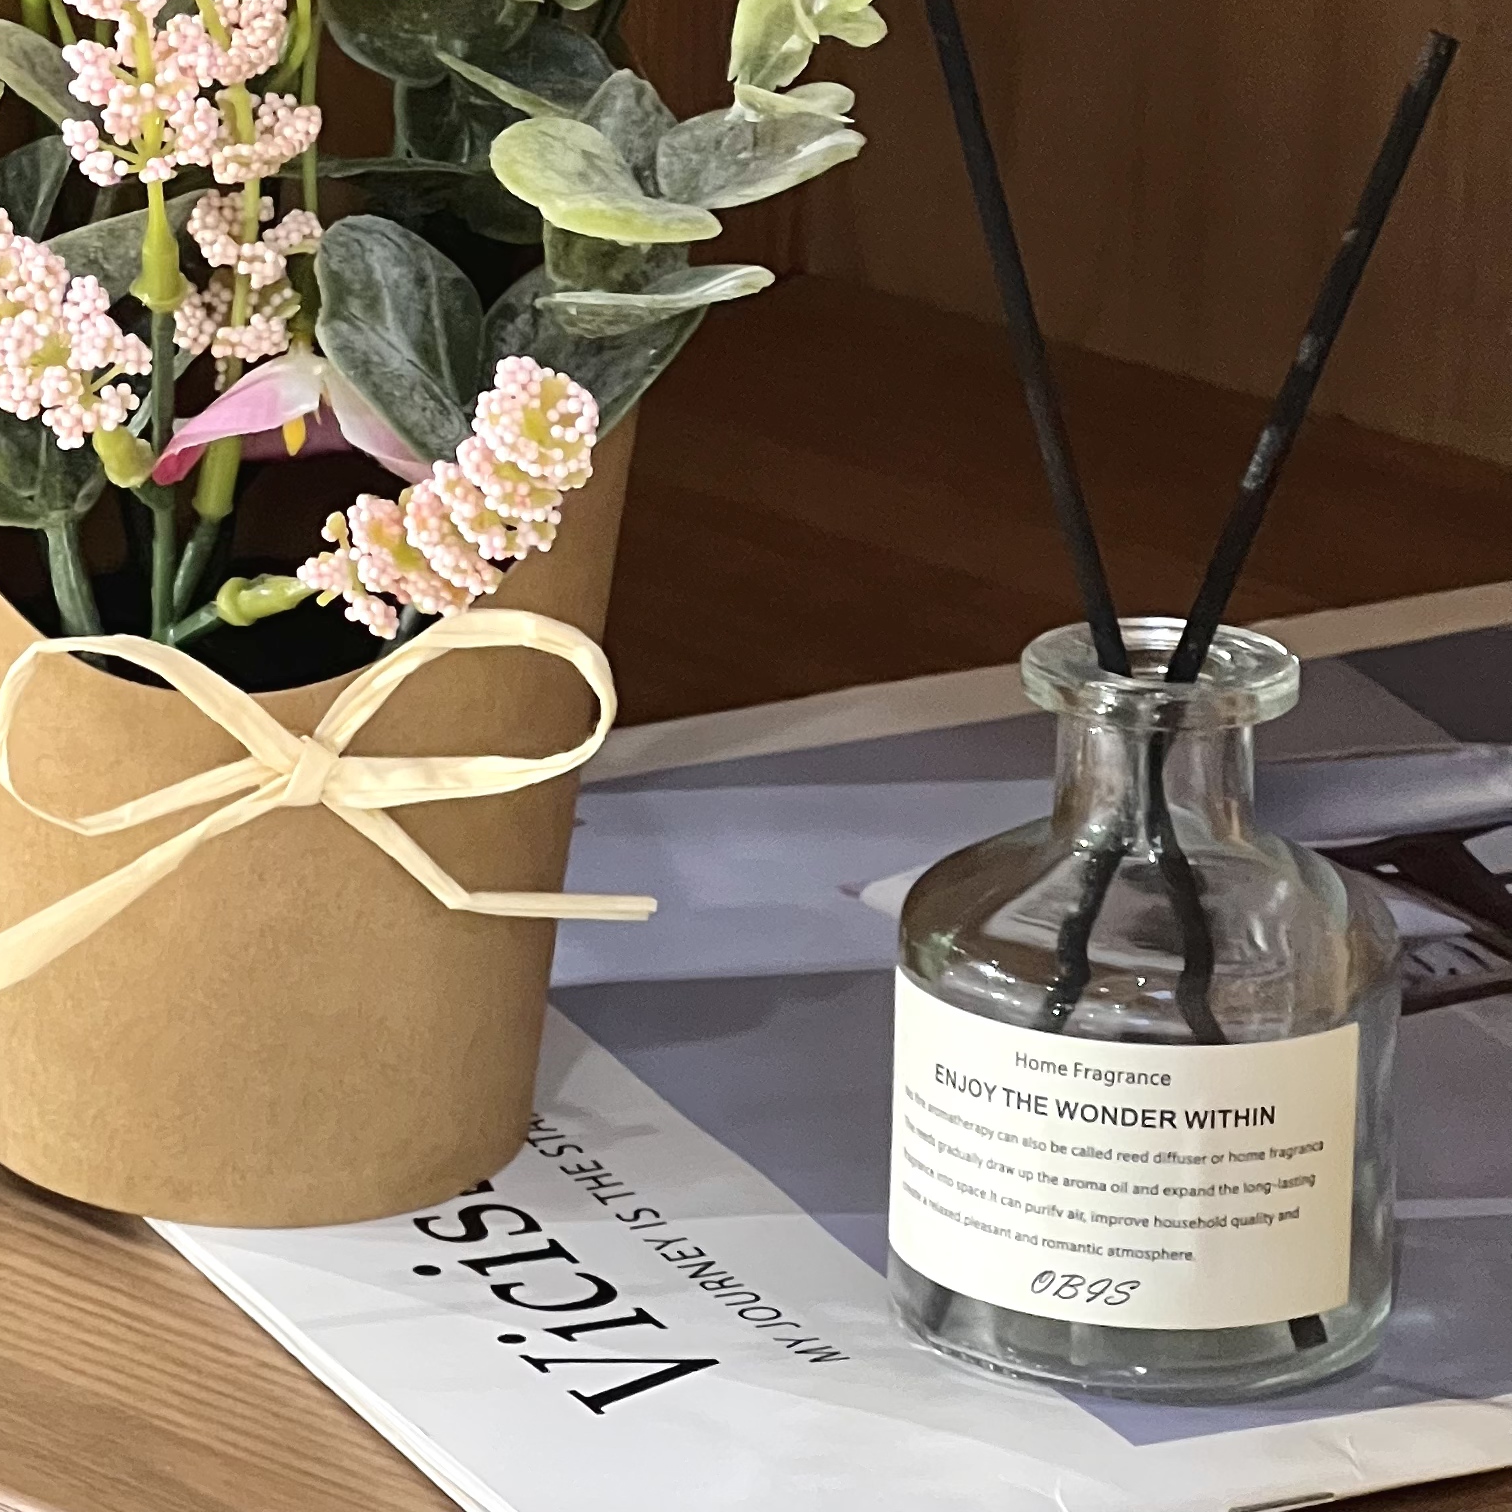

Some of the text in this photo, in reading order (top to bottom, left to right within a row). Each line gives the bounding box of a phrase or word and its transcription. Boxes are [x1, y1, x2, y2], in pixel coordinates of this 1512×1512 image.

[1015, 1051, 1172, 1087] Home Fragrance
[934, 1063, 1276, 1129] ENJOY THE WONDER WITHIN
[997, 1131, 1019, 1144] can
[1022, 1136, 1047, 1152] also
[1050, 1140, 1067, 1155] be
[1071, 1145, 1113, 1161] called
[1116, 1149, 1150, 1164] reed
[1153, 1150, 1207, 1165] diffuser
[1210, 1153, 1225, 1165] or
[1228, 1149, 1266, 1163] home
[986, 1157, 1015, 1175] draw
[1018, 1169, 1034, 1182] up
[1037, 1170, 1059, 1186] the
[1062, 1175, 1107, 1192] aroma
[1110, 1180, 1128, 1194] oil
[1132, 1183, 1159, 1196] and
[1162, 1183, 1215, 1199] expand
[1218, 1182, 1240, 1196] the
[1000, 1195, 1022, 1209] can
[1090, 1209, 1150, 1228] improve
[1153, 1214, 1228, 1230] household
[526, 1112, 851, 1364] MY JOURNEY IS THE STA
[1014, 1230, 1039, 1246] and
[1041, 1236, 1104, 1256] romantic
